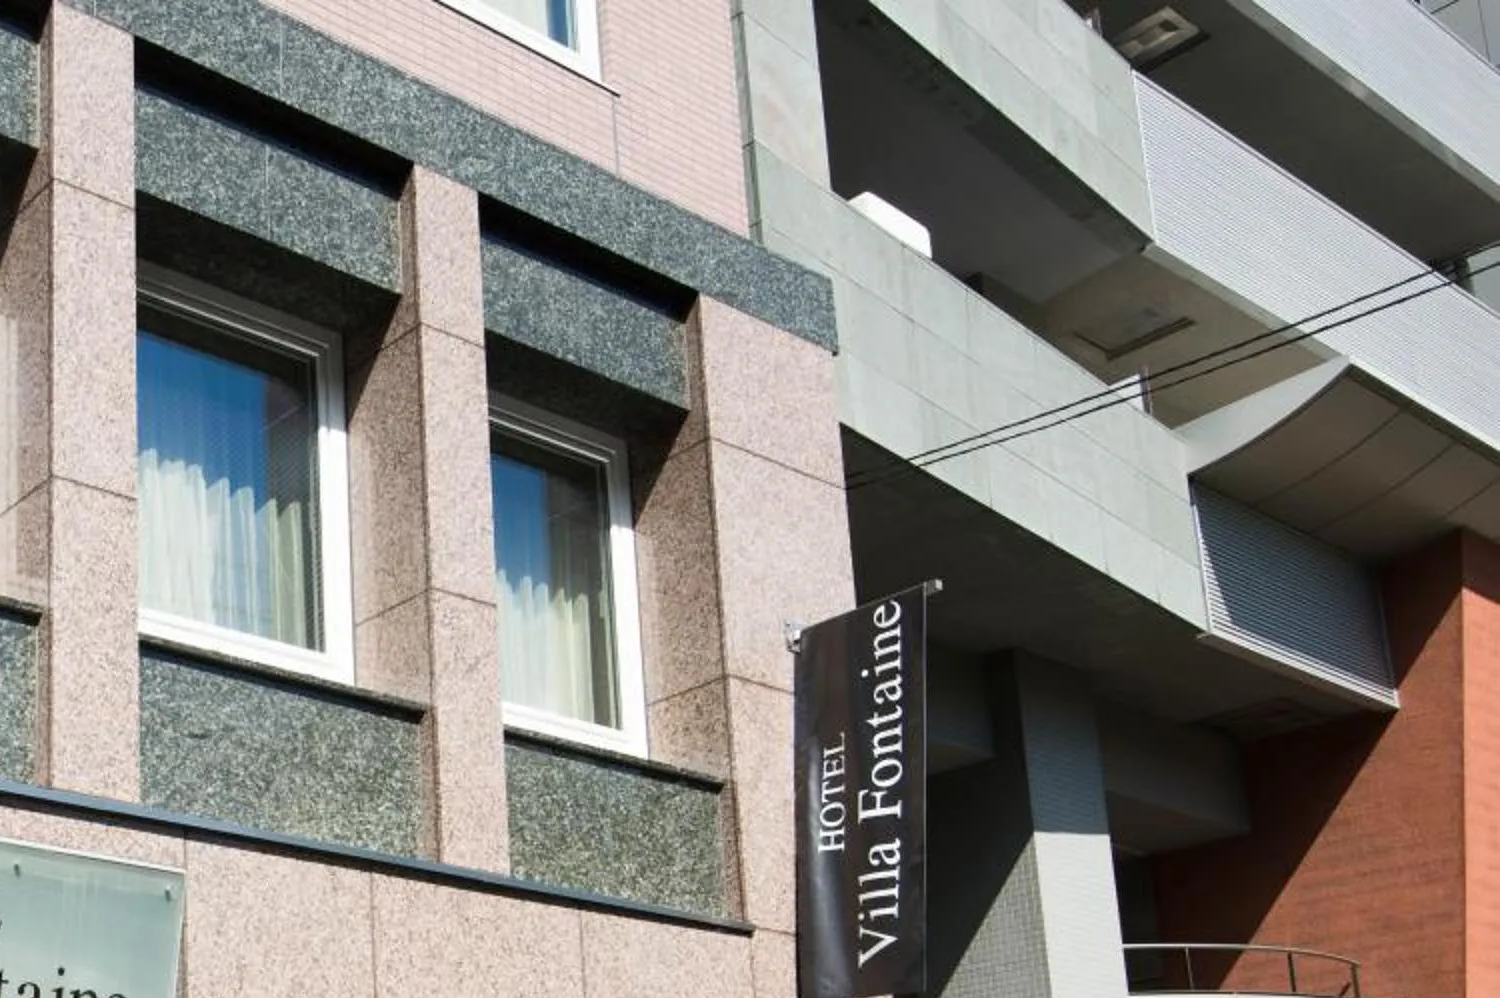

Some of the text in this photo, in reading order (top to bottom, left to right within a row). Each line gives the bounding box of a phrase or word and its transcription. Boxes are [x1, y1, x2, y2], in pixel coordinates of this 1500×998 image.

[817, 731, 846, 855] HOTEL
[857, 599, 904, 968] Villa Fontaine
